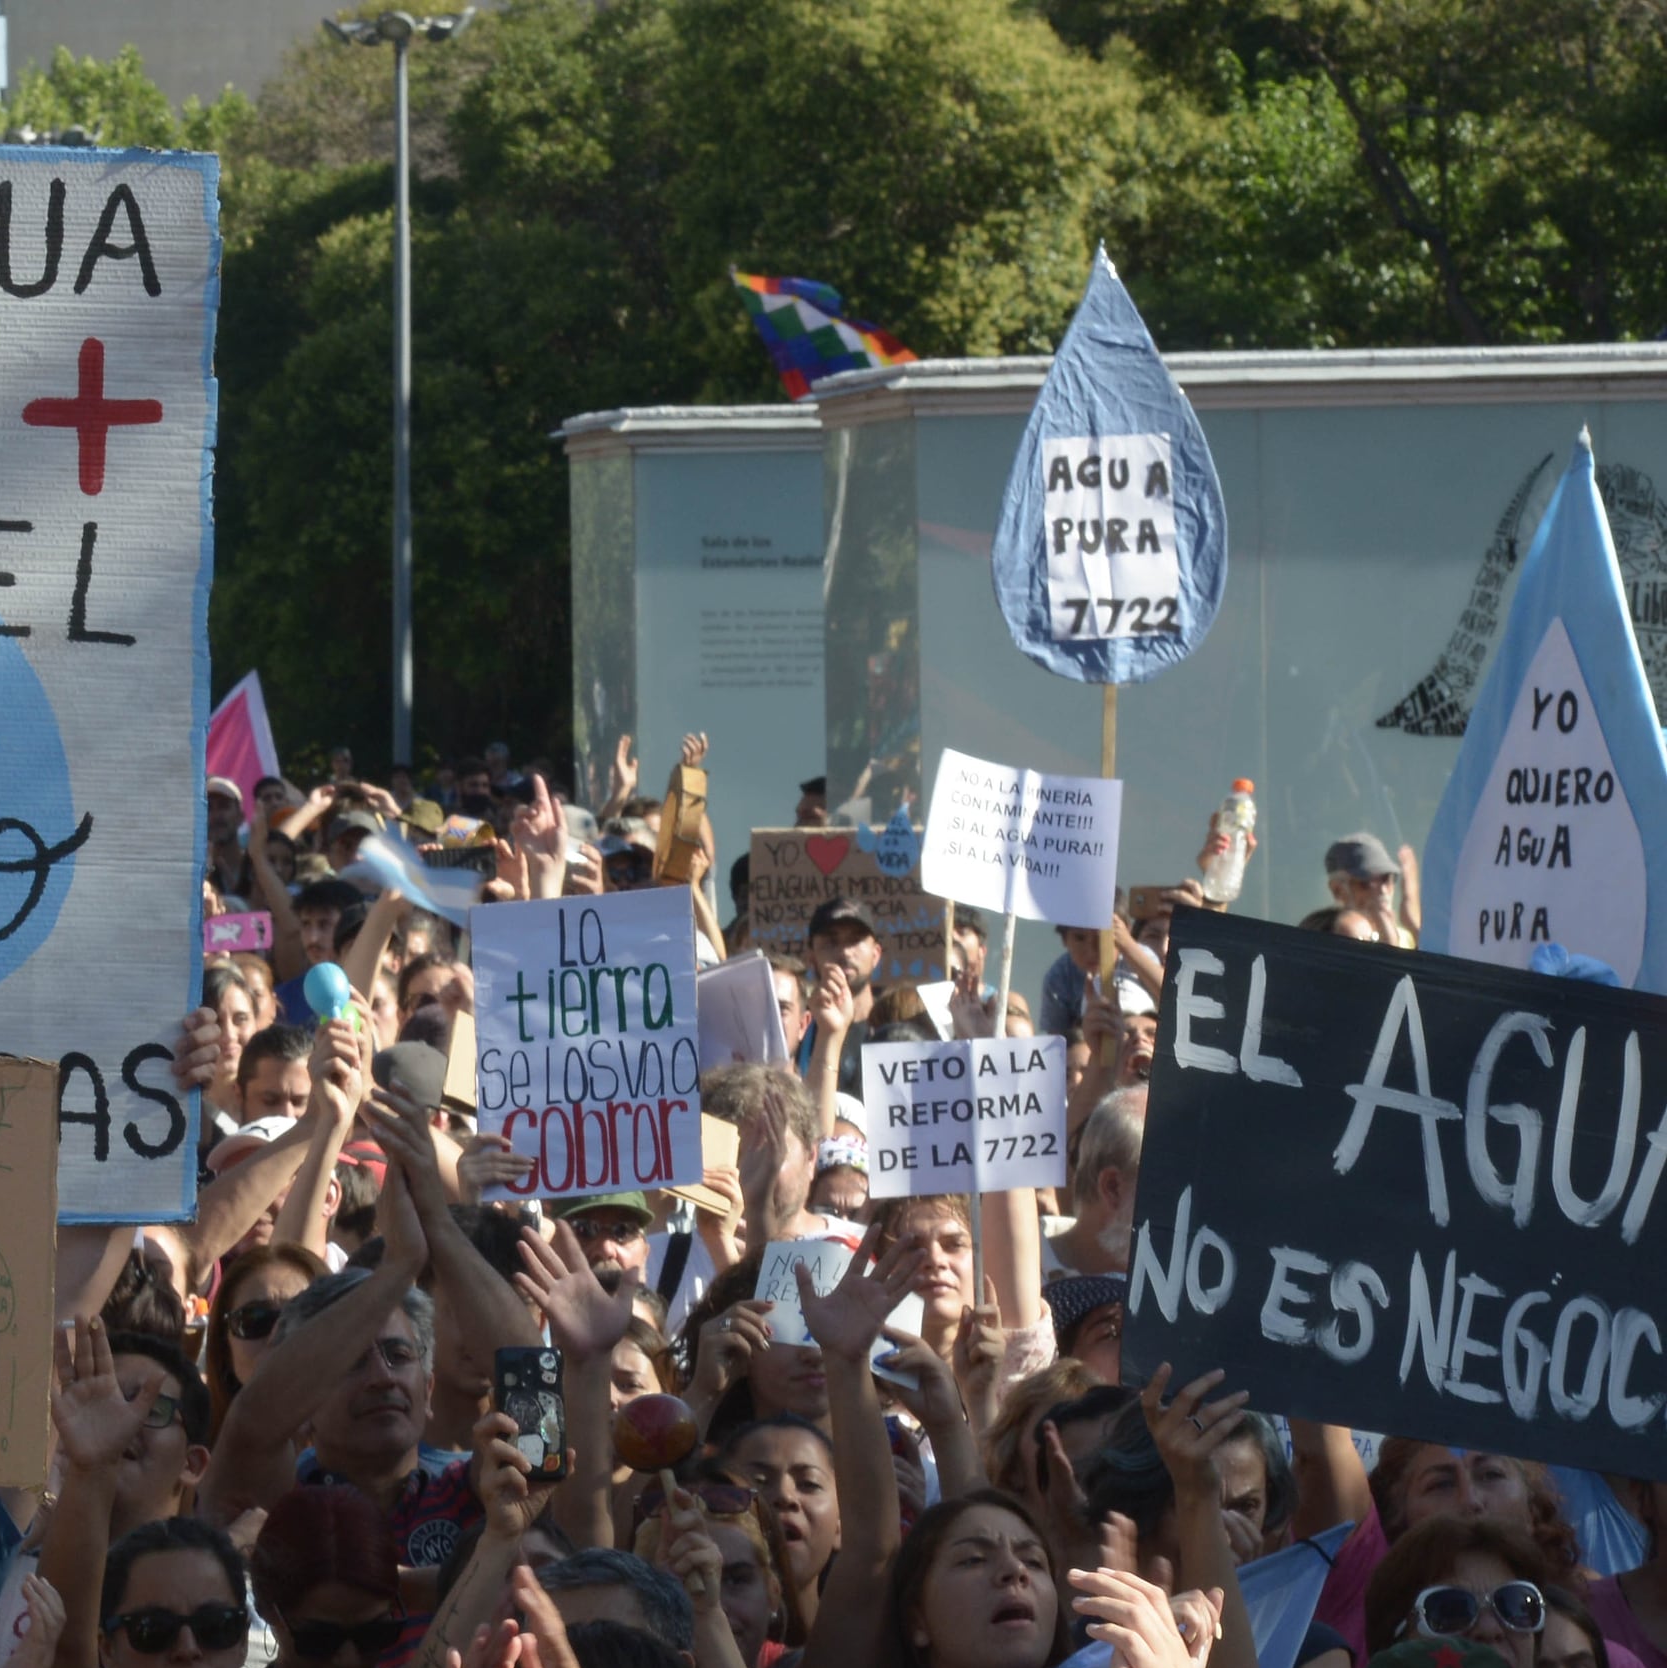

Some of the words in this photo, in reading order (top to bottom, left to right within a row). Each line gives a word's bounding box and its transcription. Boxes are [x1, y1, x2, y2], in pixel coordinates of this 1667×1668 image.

[1048, 455, 1169, 499] AGUA
[1053, 518, 1162, 555] PURA
[1061, 597, 1181, 635] 7722
[1532, 686, 1579, 734] YO
[984, 779, 993, 789] A
[999, 782, 1020, 795] LA
[1027, 786, 1092, 806] MINERÍA
[1506, 767, 1614, 808] QUIERO
[951, 790, 1093, 830] CONTAMINANTE!!!
[763, 841, 800, 867] YO
[970, 823, 987, 837] AL
[995, 829, 1038, 849] AGUA
[1043, 838, 1104, 857] PURA!!
[1495, 824, 1572, 869] AGUA
[876, 851, 909, 868] VIDA
[967, 847, 977, 859] A
[982, 850, 1003, 866] LA
[1009, 854, 1060, 879] VIDA!!!
[755, 903, 783, 924] NO
[1479, 901, 1550, 945] PURA
[506, 963, 674, 1042] tierra
[1174, 949, 1303, 1087] EL
[878, 1056, 965, 1086] VETO
[978, 1054, 998, 1077] A
[1009, 1049, 1047, 1074] LA
[888, 1092, 1043, 1128] REFORMA
[878, 1148, 918, 1172] DE
[932, 1142, 973, 1167] LA
[984, 1133, 1058, 1162] 7722
[1129, 1184, 1236, 1322] NO
[1261, 1247, 1389, 1365] ES
[1400, 1249, 1667, 1430] NEGOC
